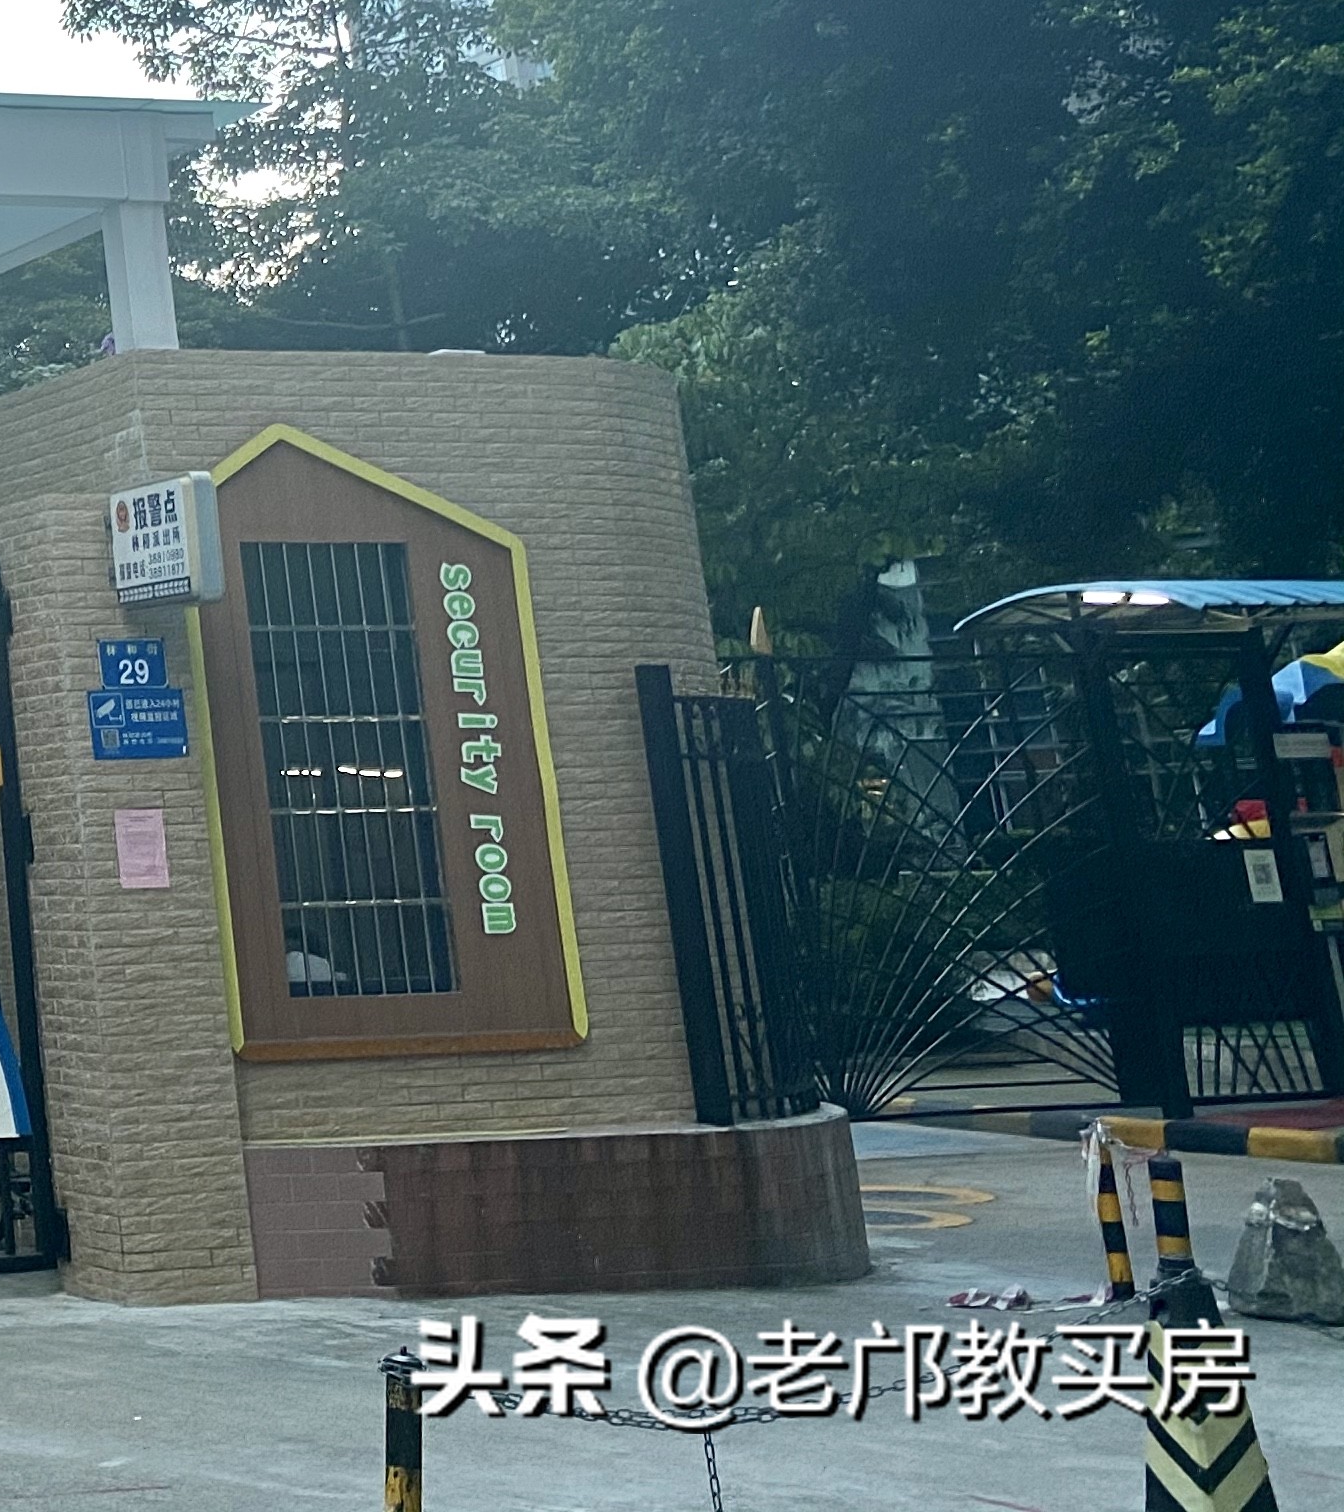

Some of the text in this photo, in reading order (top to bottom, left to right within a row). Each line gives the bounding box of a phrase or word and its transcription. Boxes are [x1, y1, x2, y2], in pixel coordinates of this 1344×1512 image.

[133, 489, 178, 530] 报警点
[119, 658, 150, 685] 29
[440, 562, 518, 936] security room
